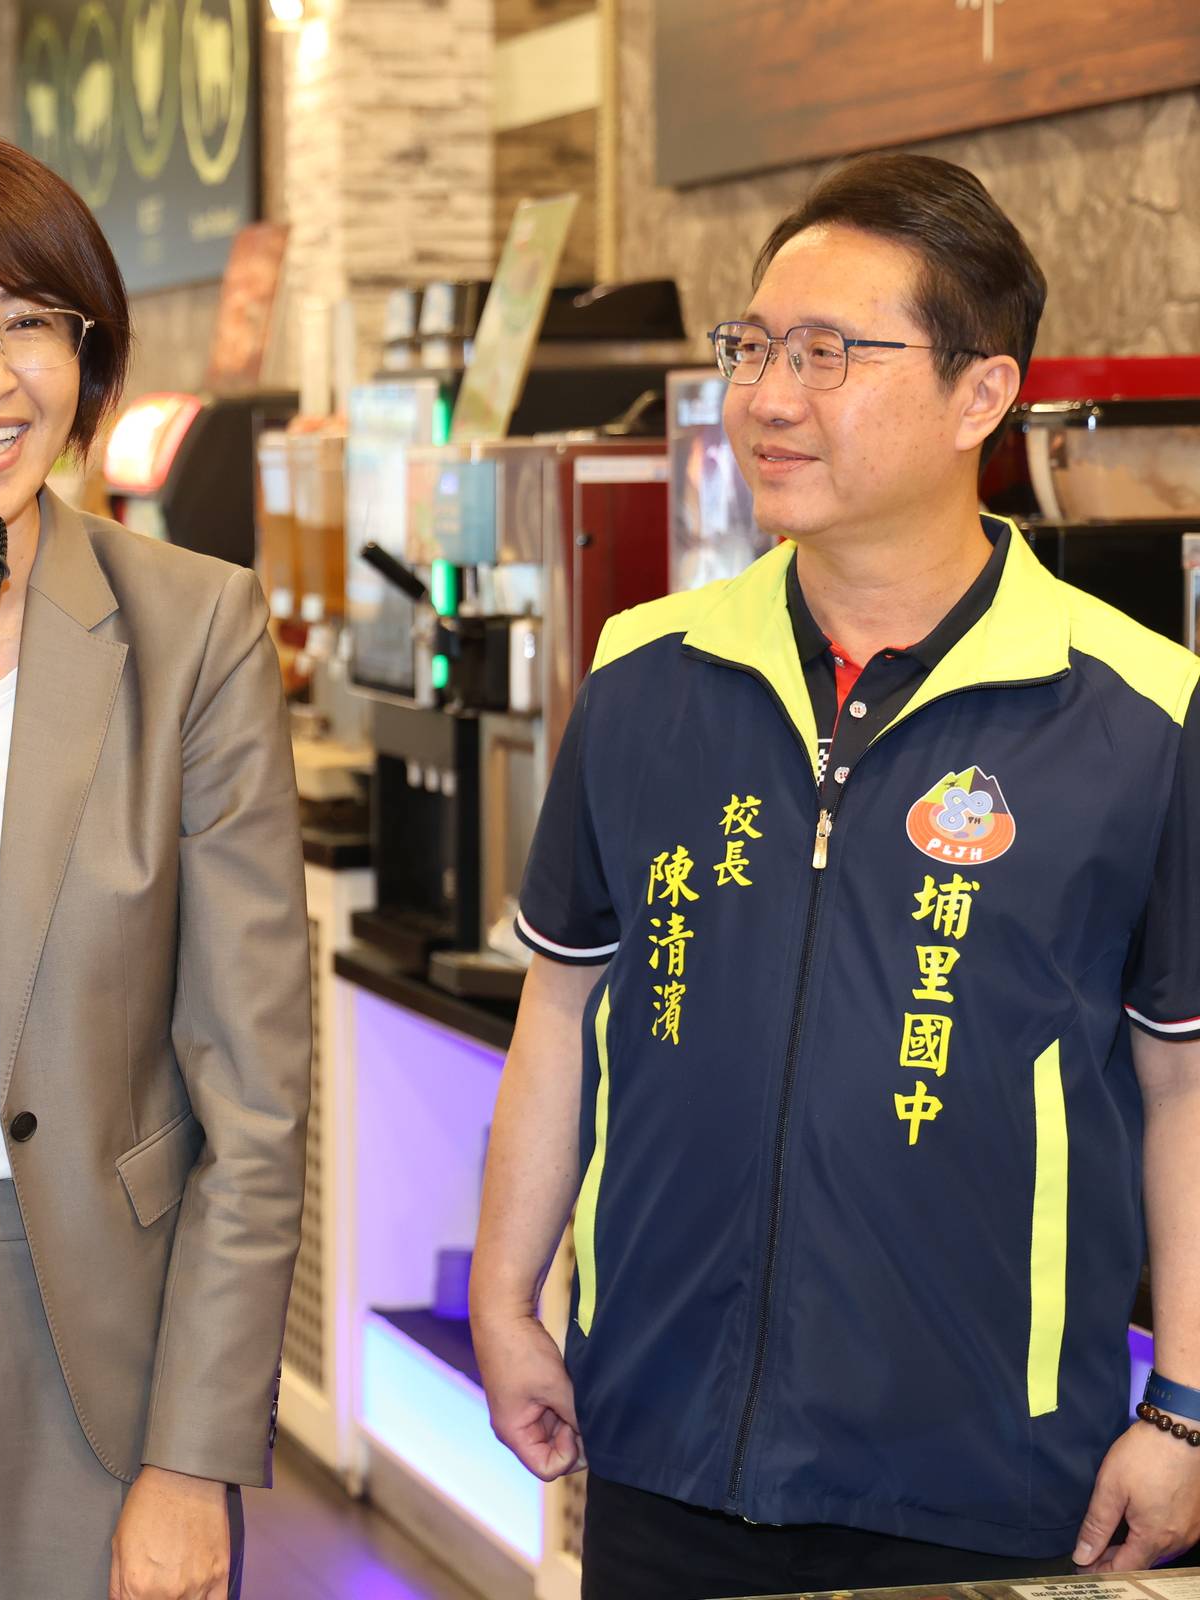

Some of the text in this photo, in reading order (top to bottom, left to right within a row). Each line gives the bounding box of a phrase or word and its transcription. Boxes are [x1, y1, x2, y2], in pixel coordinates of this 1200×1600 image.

[711, 794, 763, 887] 校長
[926, 837, 983, 861] PLJH
[647, 845, 700, 1046] 陳清濱
[894, 873, 981, 1146] 埔里國中
